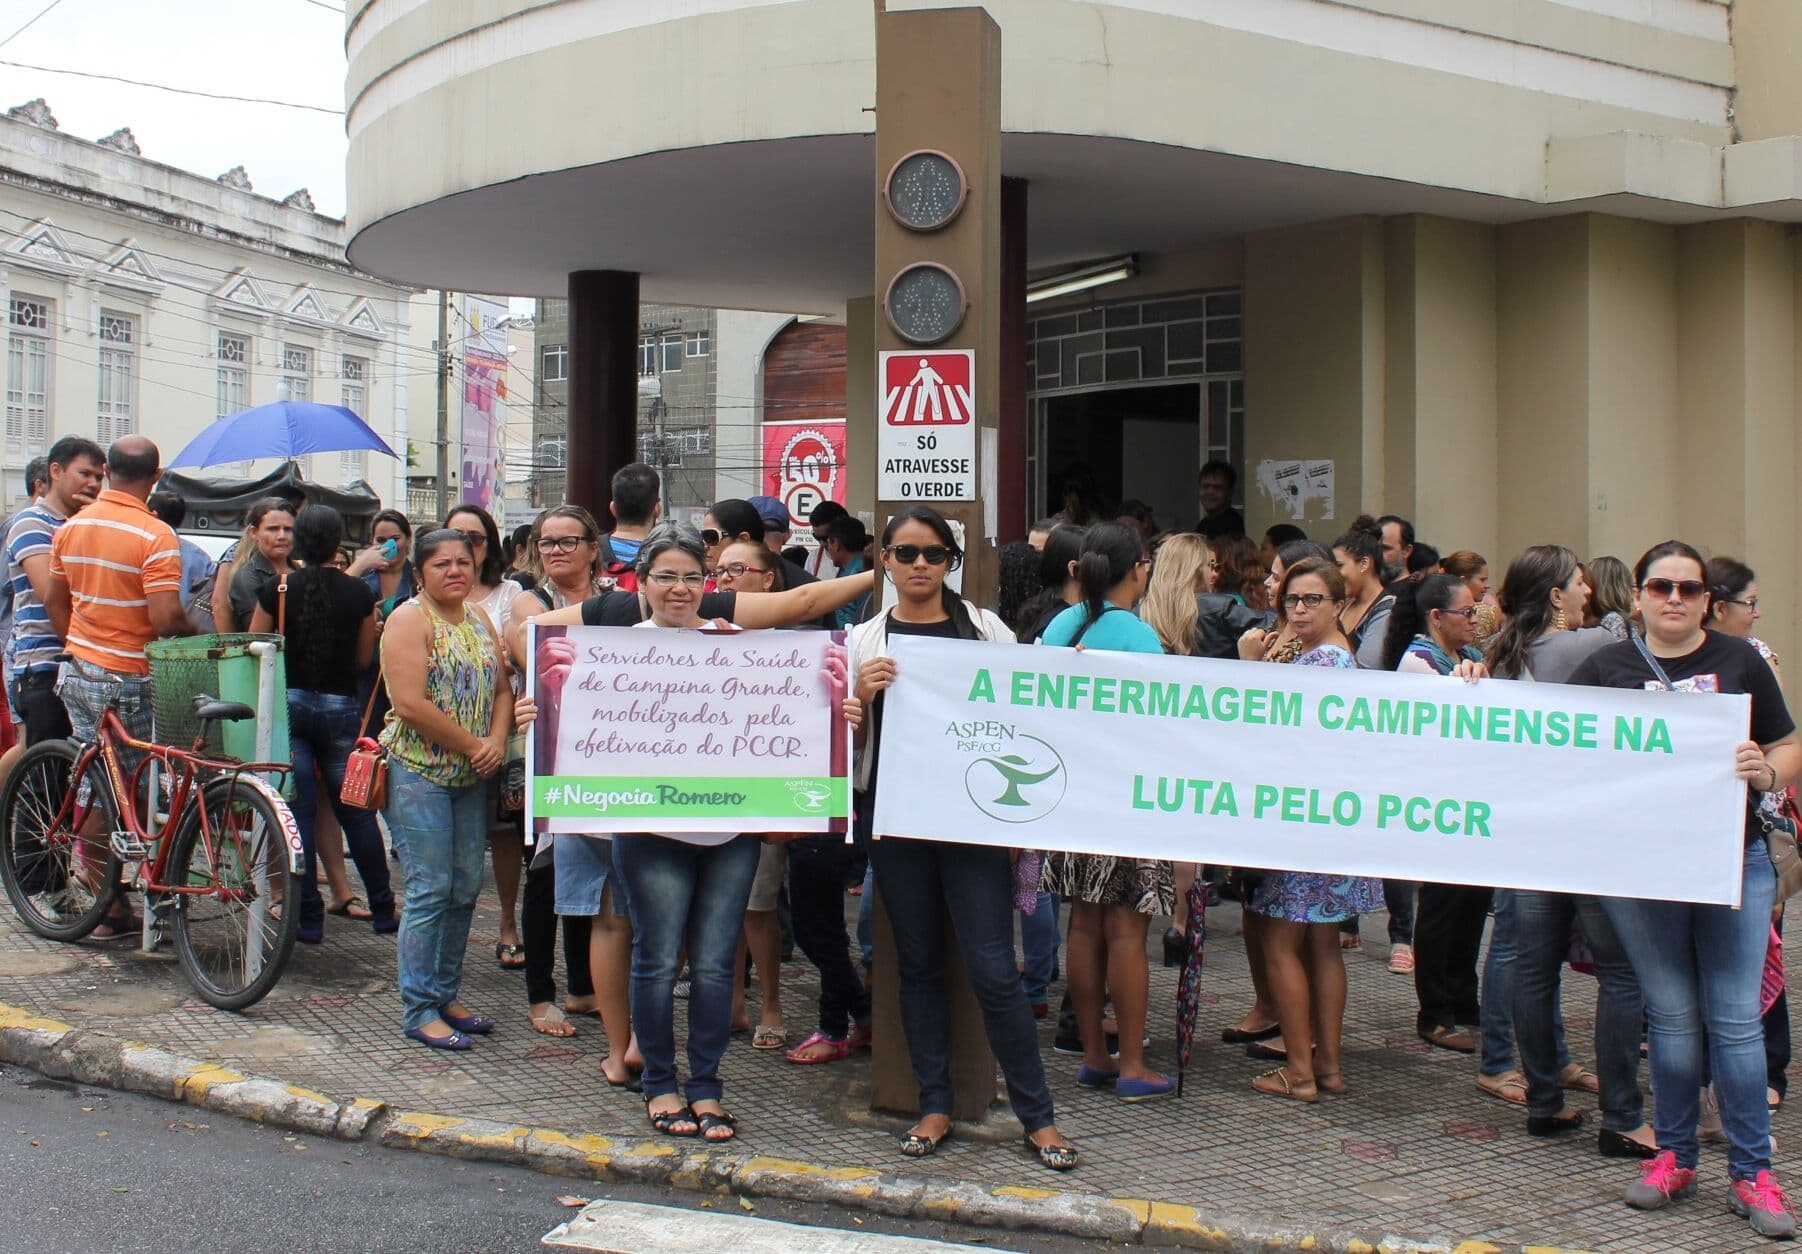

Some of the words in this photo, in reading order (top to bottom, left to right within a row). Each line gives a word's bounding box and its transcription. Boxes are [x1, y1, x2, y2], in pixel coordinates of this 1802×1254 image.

[917, 431, 937, 450] SÓ
[885, 459, 969, 474] ATRAVESSE
[901, 482, 912, 497] O
[915, 482, 964, 497] VERDE
[797, 493, 813, 517] E
[583, 646, 701, 667] Servidores
[705, 647, 735, 667] da
[740, 649, 811, 669] Saúde
[579, 671, 606, 692] de
[613, 673, 716, 705] Campina
[721, 676, 810, 701] Grande,
[592, 700, 733, 733] mobilizados
[743, 703, 797, 737] pela
[968, 668, 996, 704] A
[1010, 671, 1303, 727] ENFERMAGEM
[1318, 694, 1599, 749] CAMPINENSE
[1614, 715, 1674, 754] NA
[945, 720, 1016, 740] ASPEN
[574, 727, 687, 759] efetivação
[696, 732, 723, 756] do
[732, 735, 808, 759] PCCR.
[956, 740, 1001, 753] PSF/CG
[1132, 775, 1239, 817] LUTA
[1254, 784, 1362, 827] PELO
[1377, 794, 1491, 838] PCCR
[275, 800, 303, 850] FIADO
